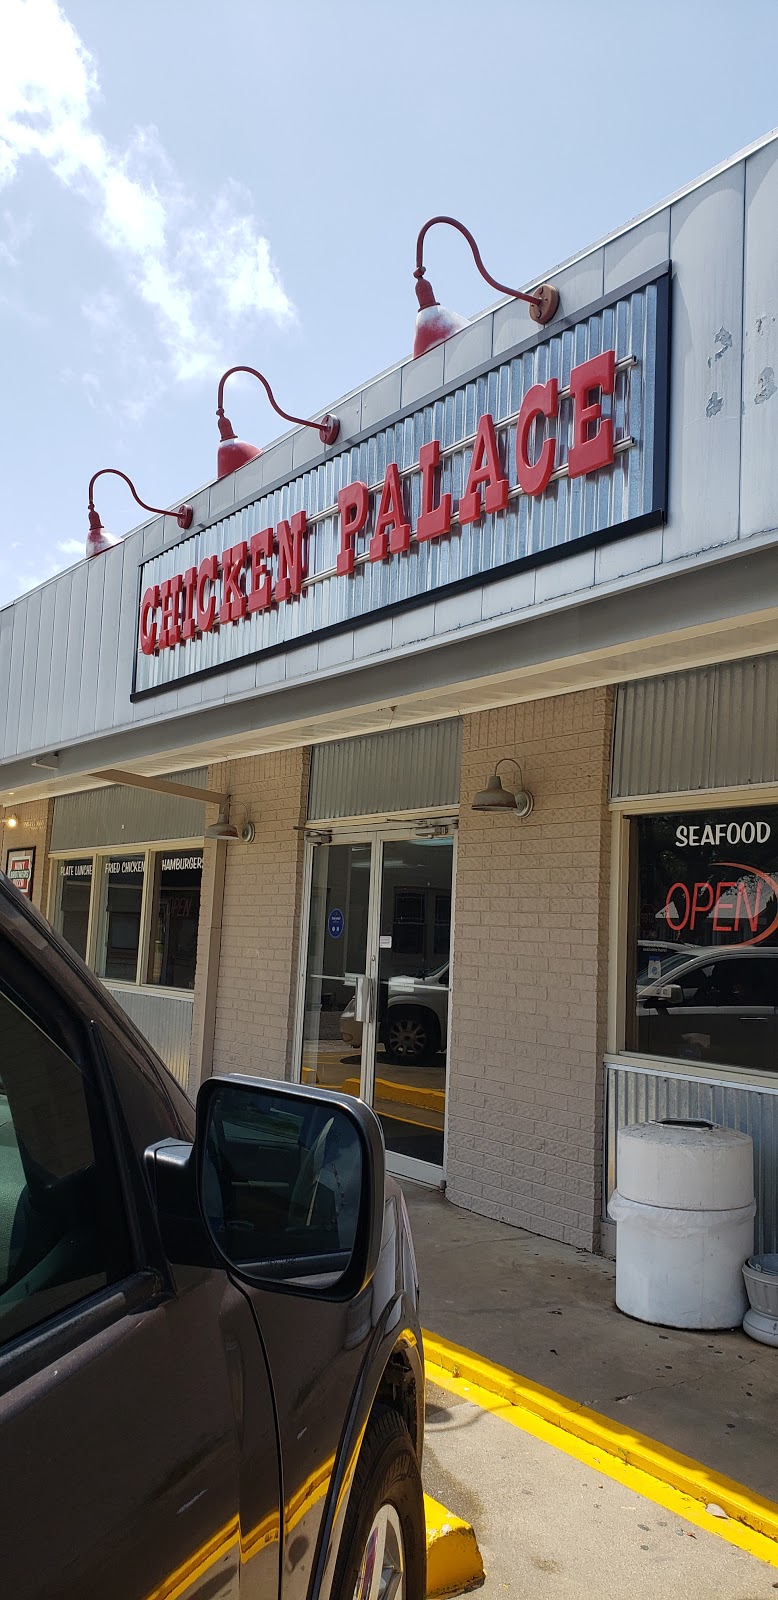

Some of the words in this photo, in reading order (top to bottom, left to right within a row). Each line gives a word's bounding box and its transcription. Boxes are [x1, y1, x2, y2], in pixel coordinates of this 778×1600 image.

[139, 510, 307, 656] CHICKEN
[336, 349, 616, 576] PALACE
[675, 821, 771, 847] SEAFOOD
[60, 865, 74, 876] PLATE
[74, 864, 93, 876] LUNCHE
[105, 862, 120, 874] FRIED
[121, 860, 145, 873] CHICKEN
[665, 882, 763, 932] OPEN
